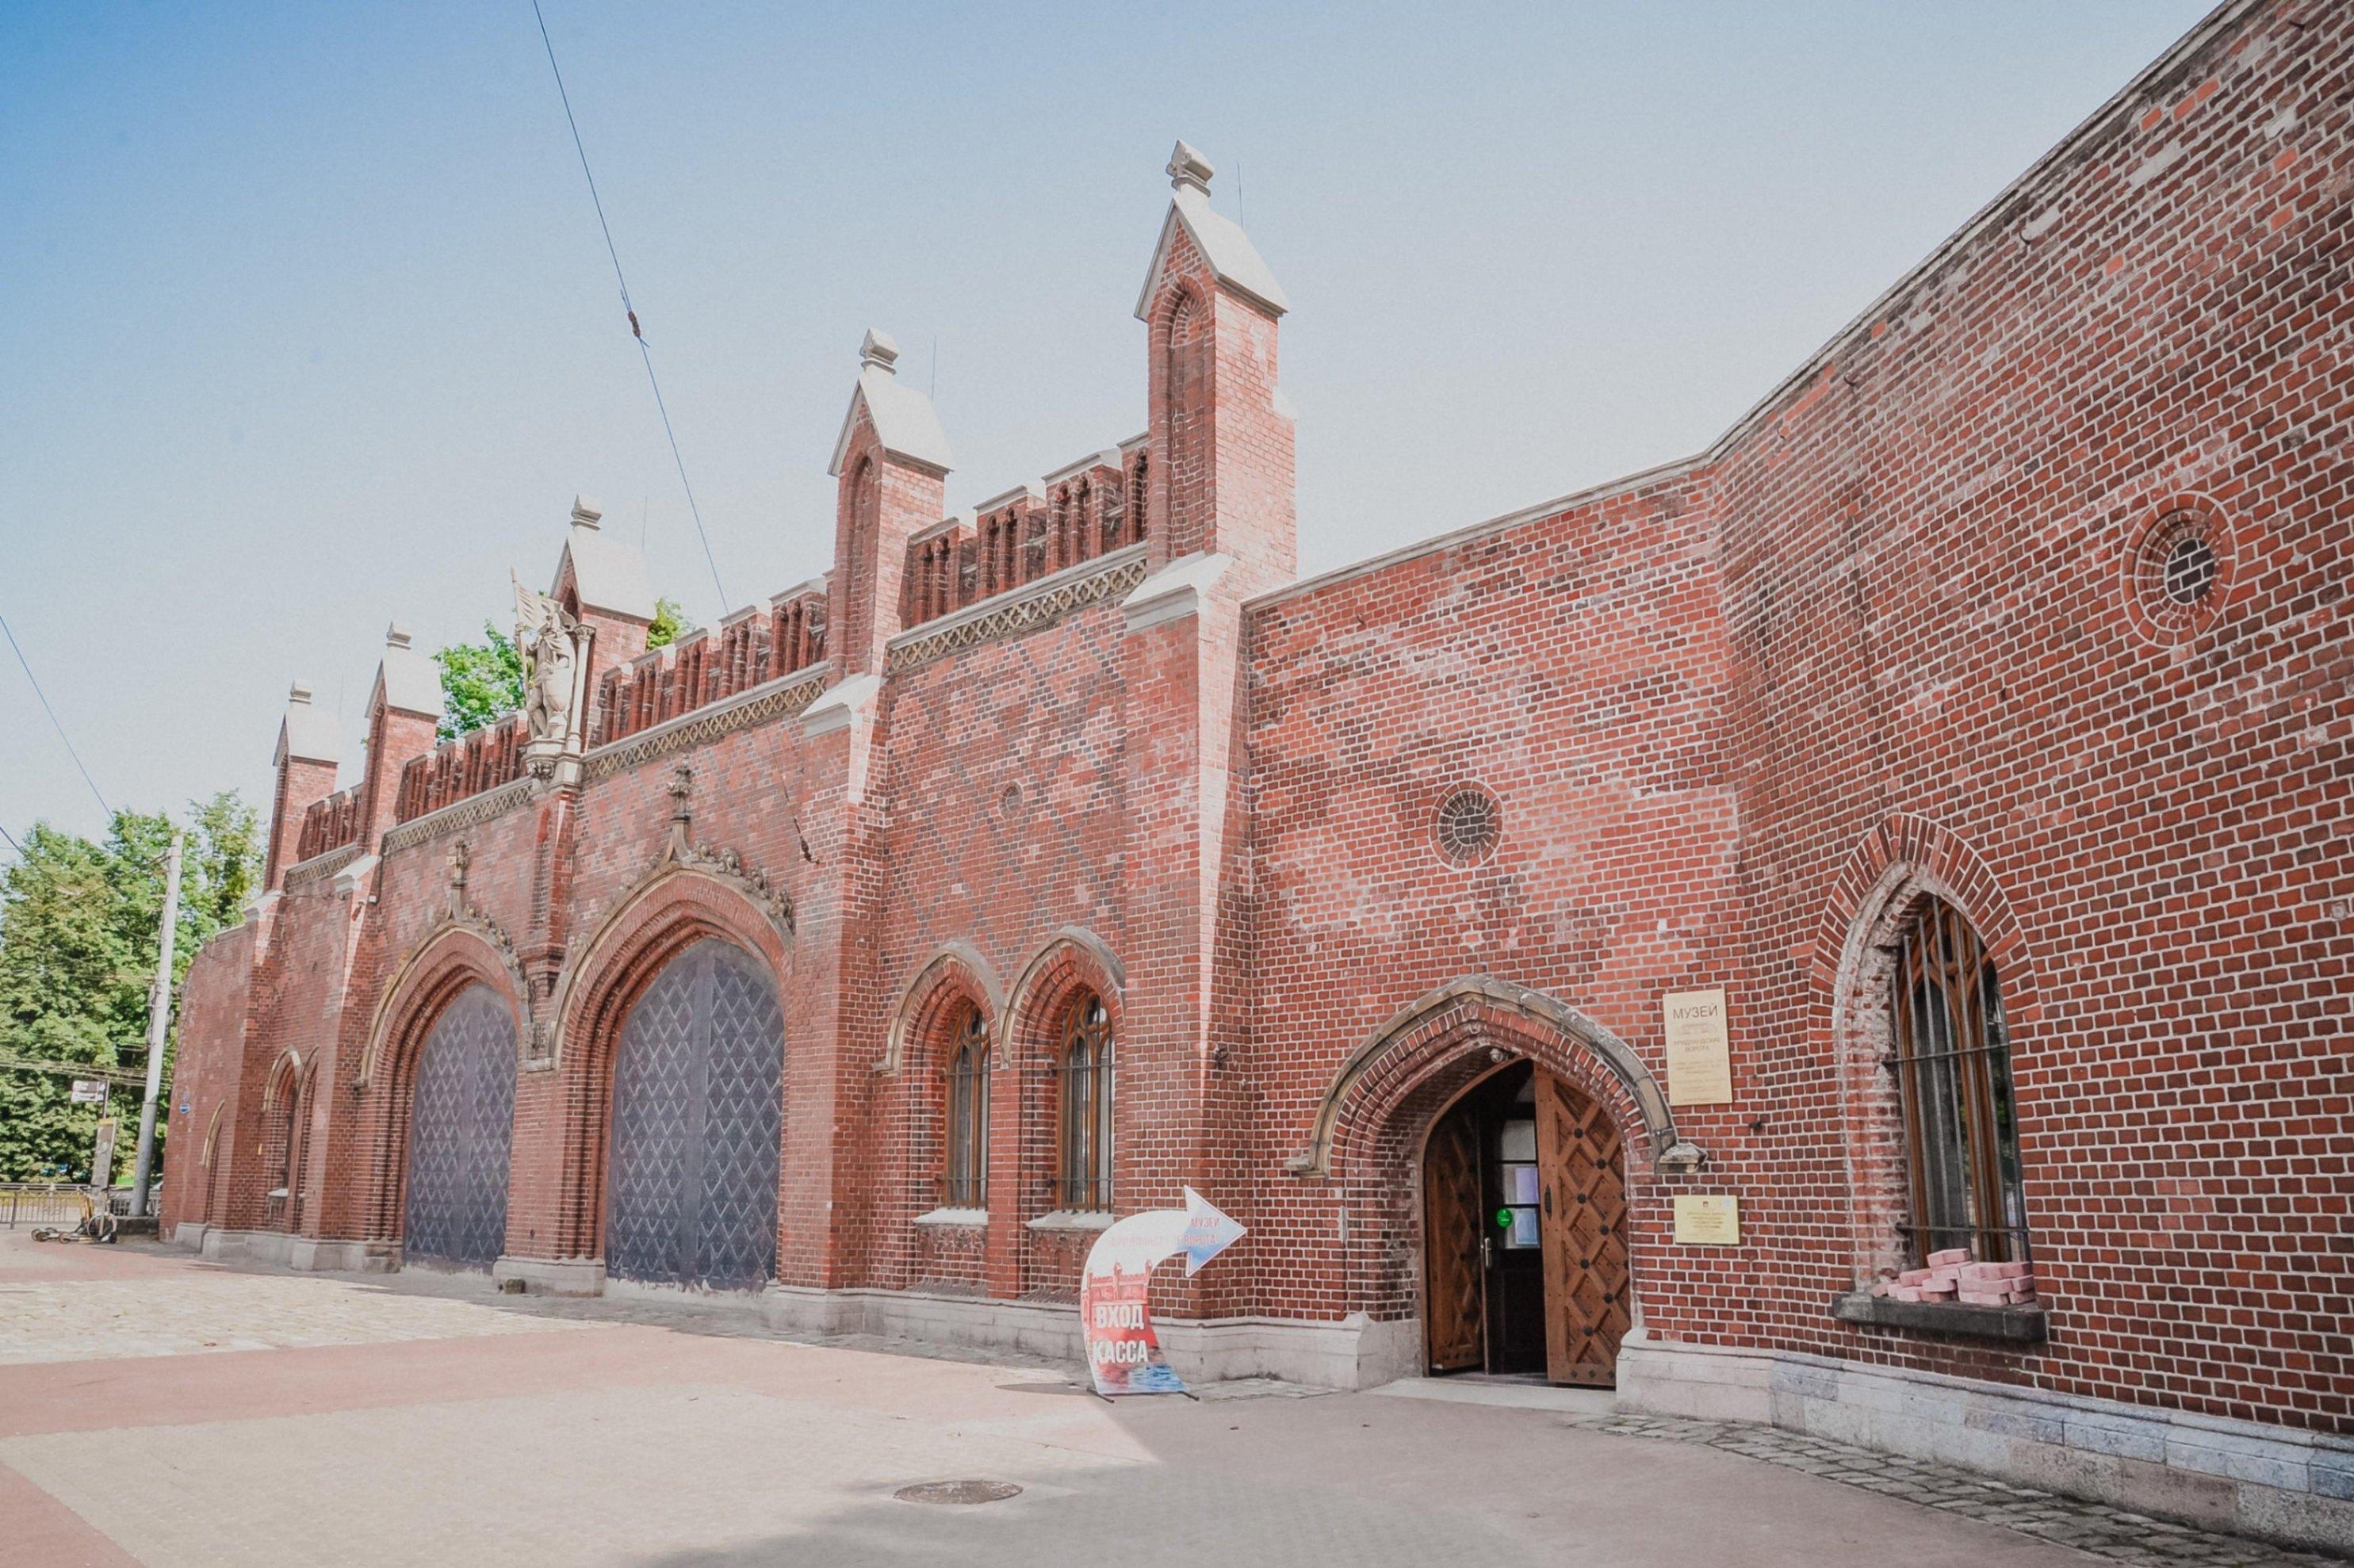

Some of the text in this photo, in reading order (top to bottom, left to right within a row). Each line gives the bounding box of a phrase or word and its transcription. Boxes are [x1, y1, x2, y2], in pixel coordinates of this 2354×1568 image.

[1673, 1004, 1718, 1019] МУЗЕЙ
[1096, 1306, 1144, 1329] ВХОД
[1093, 1340, 1148, 1363] КАССА
